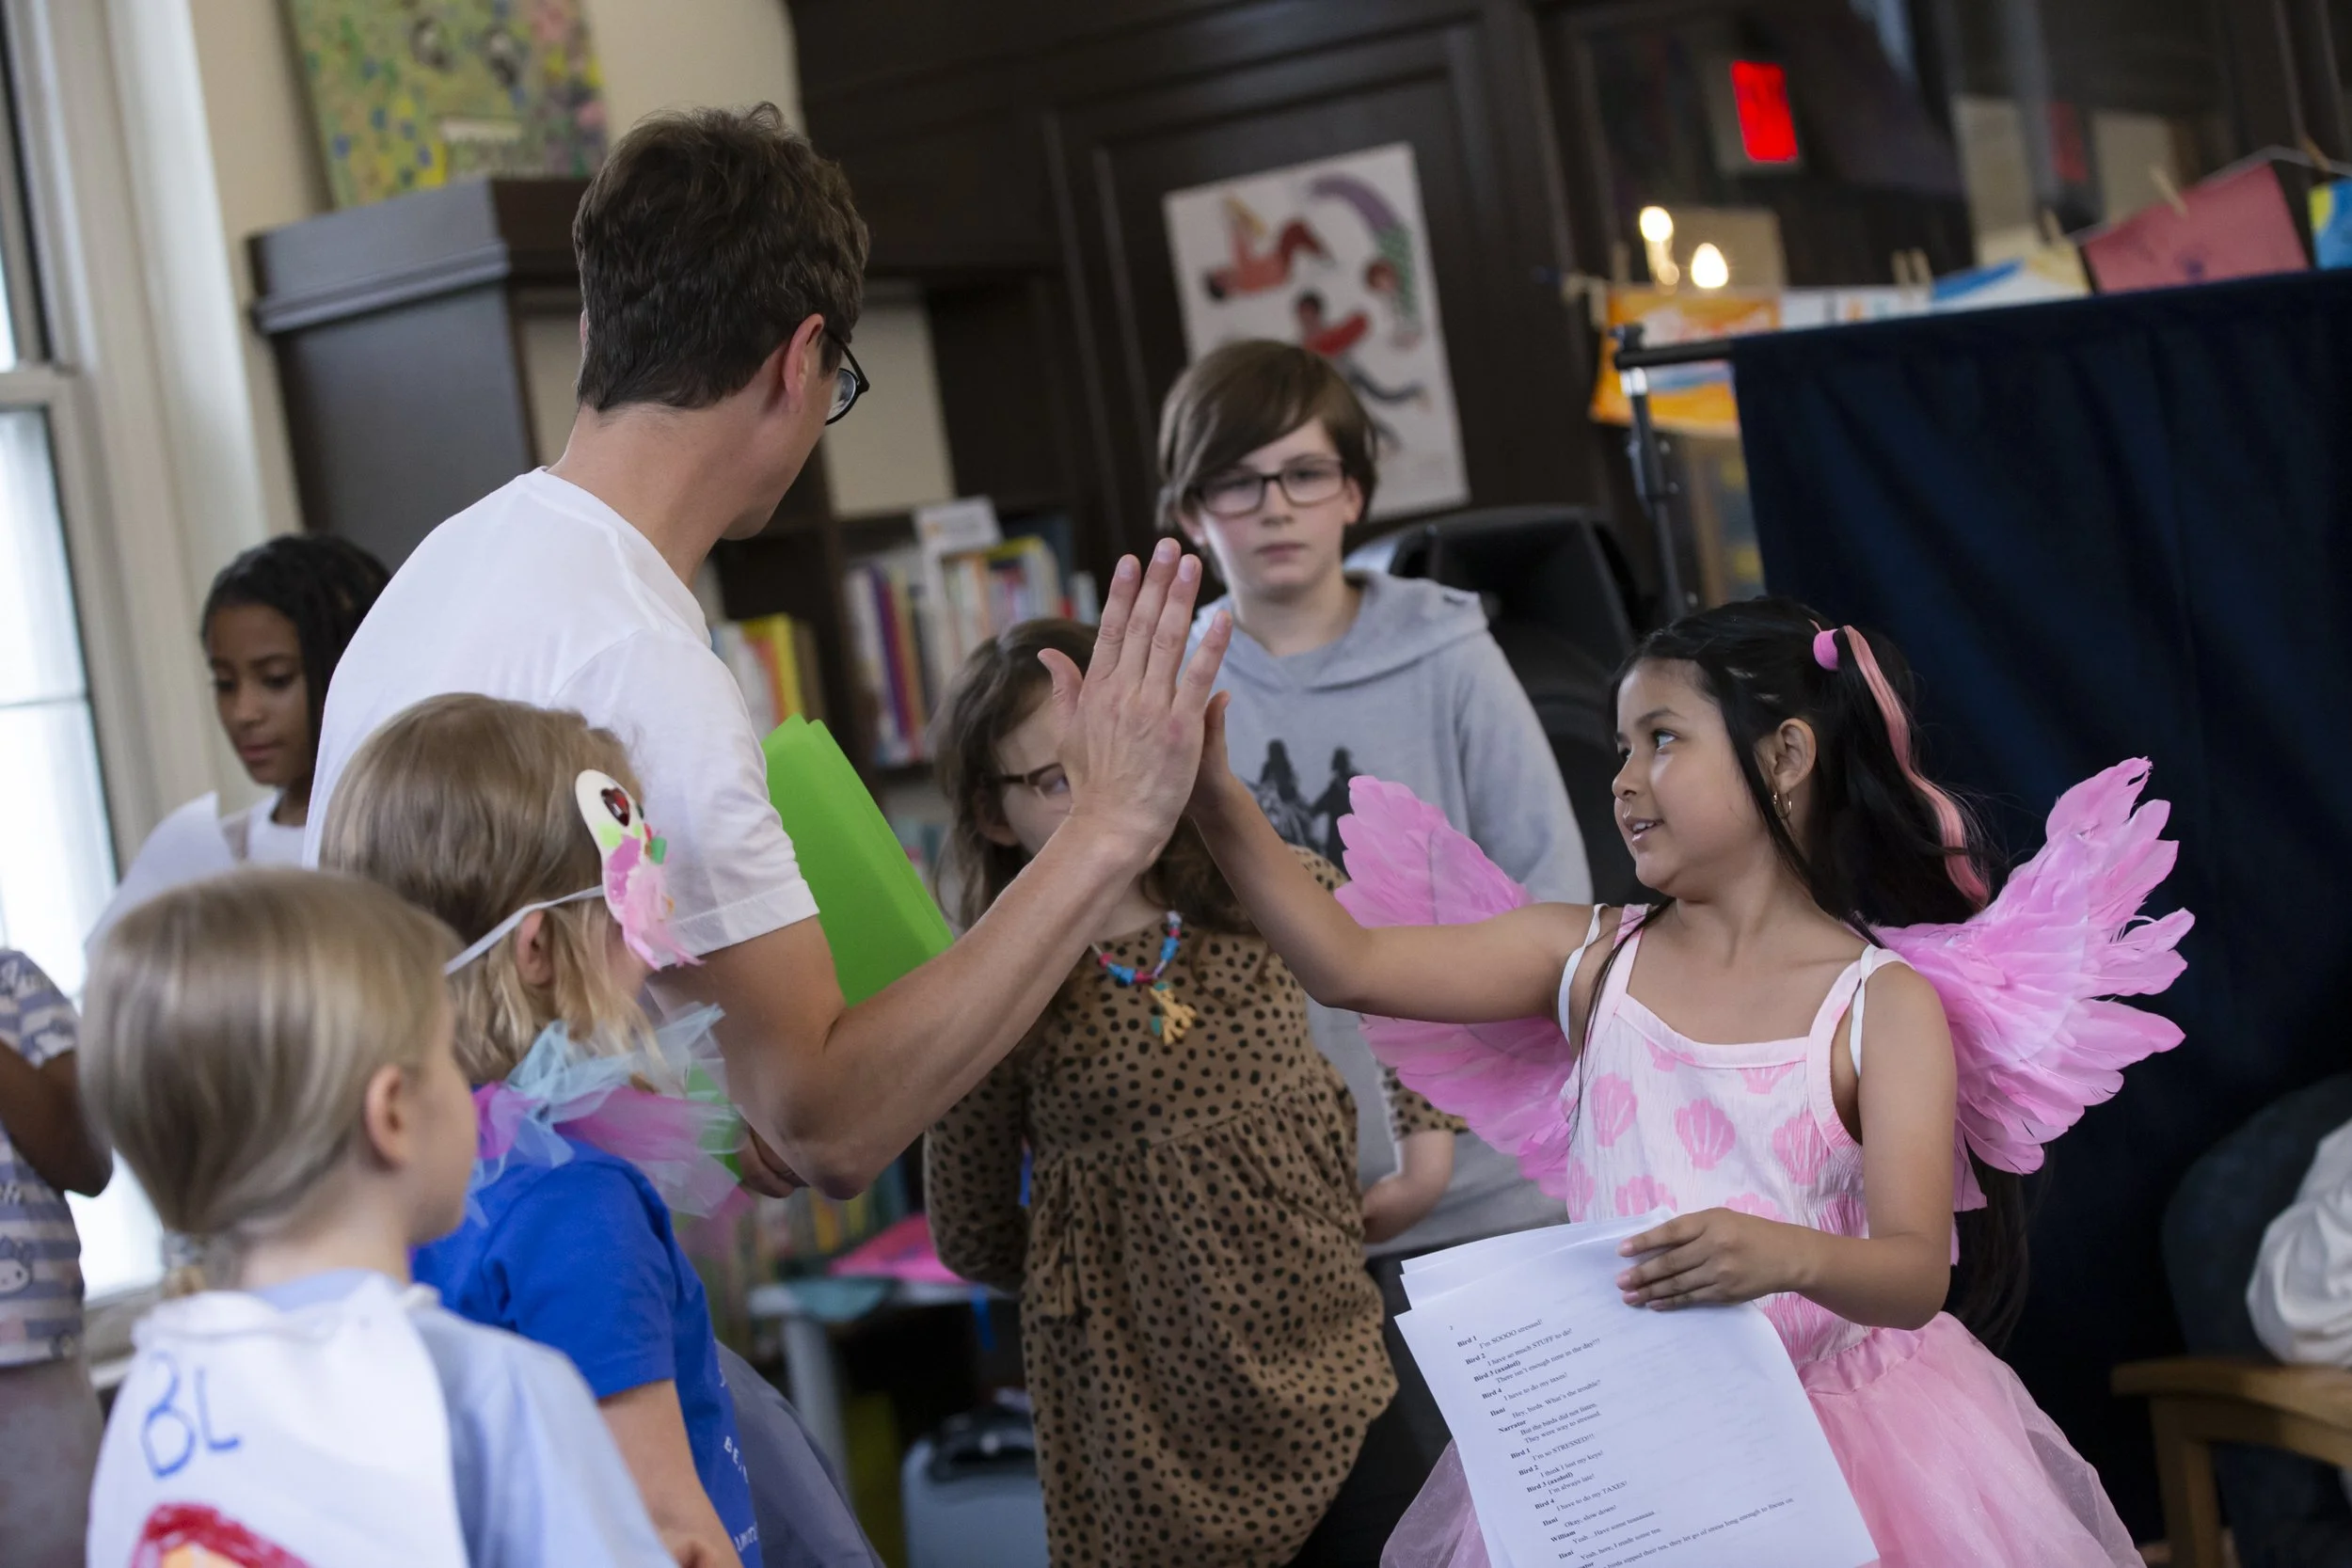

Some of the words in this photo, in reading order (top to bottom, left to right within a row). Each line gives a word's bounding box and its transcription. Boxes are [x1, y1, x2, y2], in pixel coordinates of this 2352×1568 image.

[1457, 1338, 1472, 1347] Bird
[1491, 1356, 1505, 1365] have
[1515, 1345, 1532, 1355] much
[1532, 1336, 1553, 1348] STUFF
[1466, 1355, 1481, 1365] Bird
[1474, 1372, 1488, 1382] Bird
[1495, 1360, 1520, 1374] (axolotl)
[1496, 1374, 1513, 1383] There
[1529, 1358, 1550, 1370] enough
[1550, 1354, 1564, 1362] time
[1549, 1372, 1566, 1383] taxes!
[1482, 1390, 1497, 1399] Bird
[1545, 1395, 1566, 1404] What's
[1499, 1420, 1526, 1433] Narrator
[1542, 1418, 1558, 1427] birds
[1511, 1449, 1525, 1459] Bird
[1518, 1466, 1534, 1475] Bird
[1545, 1467, 1560, 1476] think
[1527, 1483, 1541, 1493] Bird
[1548, 1472, 1573, 1485] (axolotl)
[1561, 1480, 1581, 1490] always
[1602, 1481, 1627, 1494] TAXES!
[1534, 1500, 1549, 1509] Bird
[1550, 1531, 1576, 1542] William
[1594, 1528, 1610, 1536] Have
[1624, 1553, 1643, 1563] sipped
[1708, 1524, 1724, 1532] stress
[1740, 1510, 1760, 1521] enough
[1618, 1538, 1634, 1546] made
[1635, 1531, 1650, 1540] some
